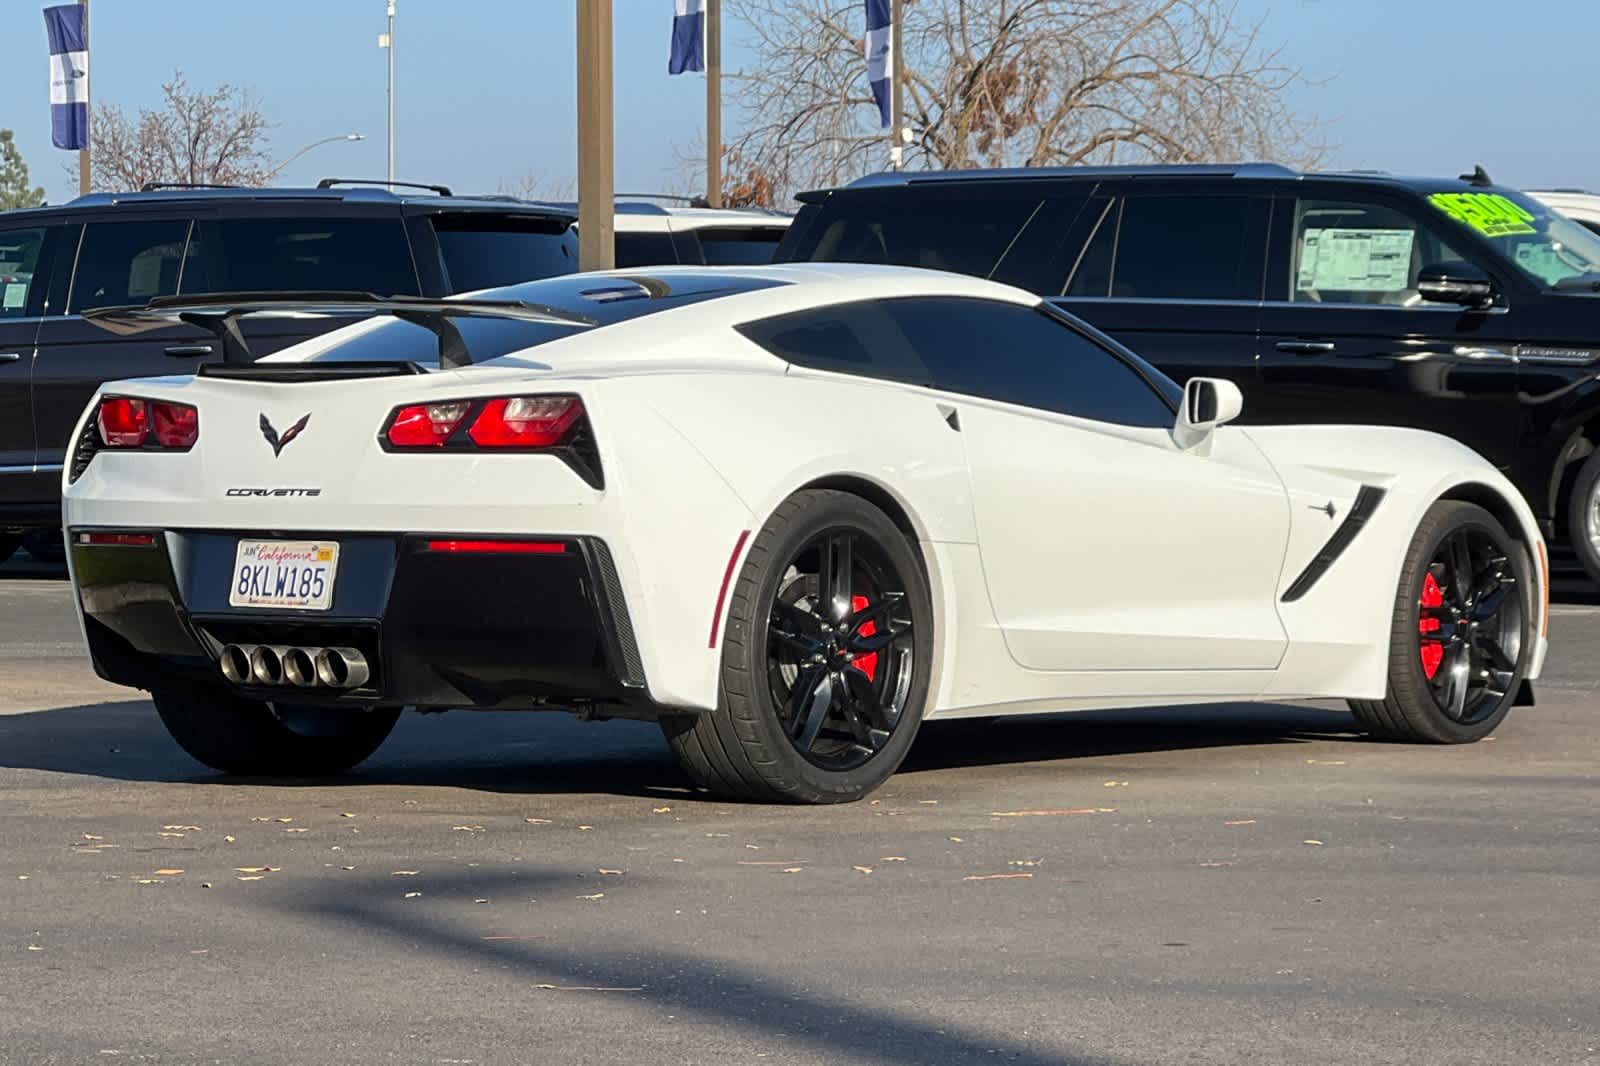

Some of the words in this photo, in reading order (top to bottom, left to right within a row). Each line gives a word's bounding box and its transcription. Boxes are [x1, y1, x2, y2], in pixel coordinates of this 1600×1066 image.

[225, 488, 321, 497] CORVETTE
[256, 544, 313, 566] California
[237, 564, 326, 599] 8KLW185
